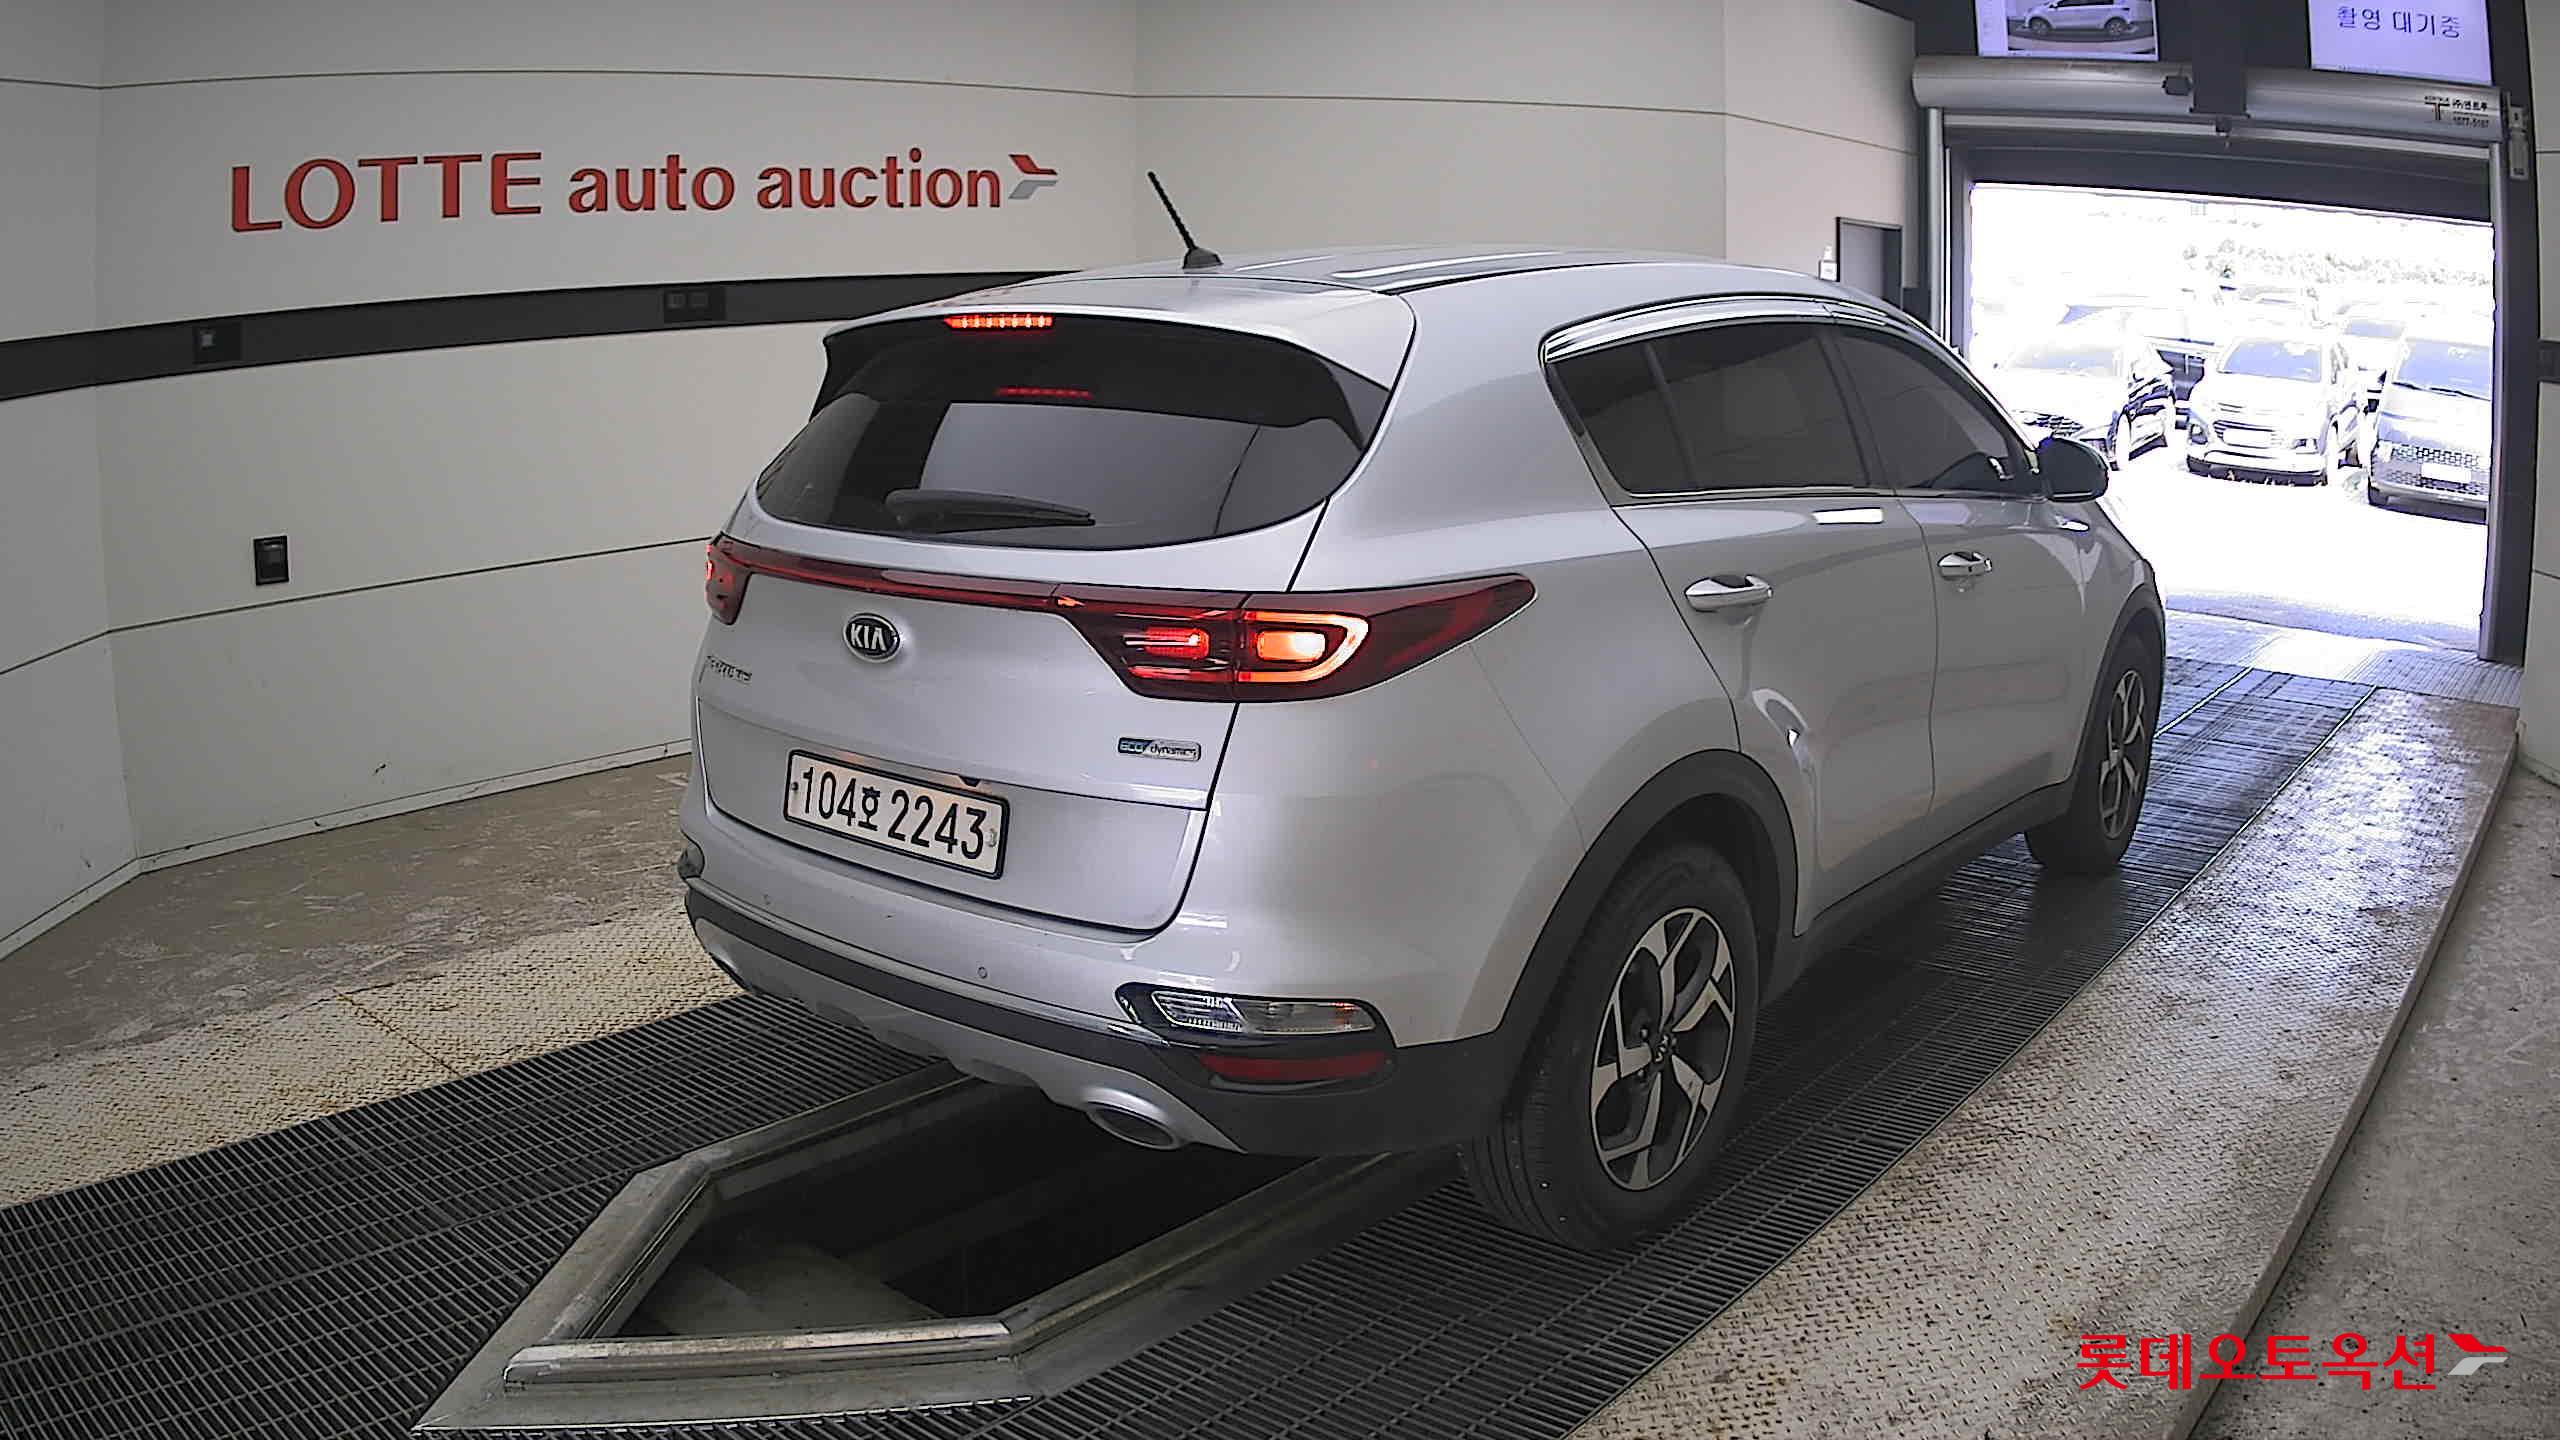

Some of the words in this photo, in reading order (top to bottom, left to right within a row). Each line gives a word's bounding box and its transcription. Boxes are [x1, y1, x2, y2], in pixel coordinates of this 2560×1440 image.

[2338, 6, 2381, 31] 촬영
[2392, 11, 2460, 38] 대기중
[233, 152, 541, 232] LOTTE
[568, 153, 736, 214] auto
[757, 148, 1001, 210] auction
[850, 623, 888, 651] KIA
[803, 766, 881, 831] 104호
[887, 789, 987, 860] 2243
